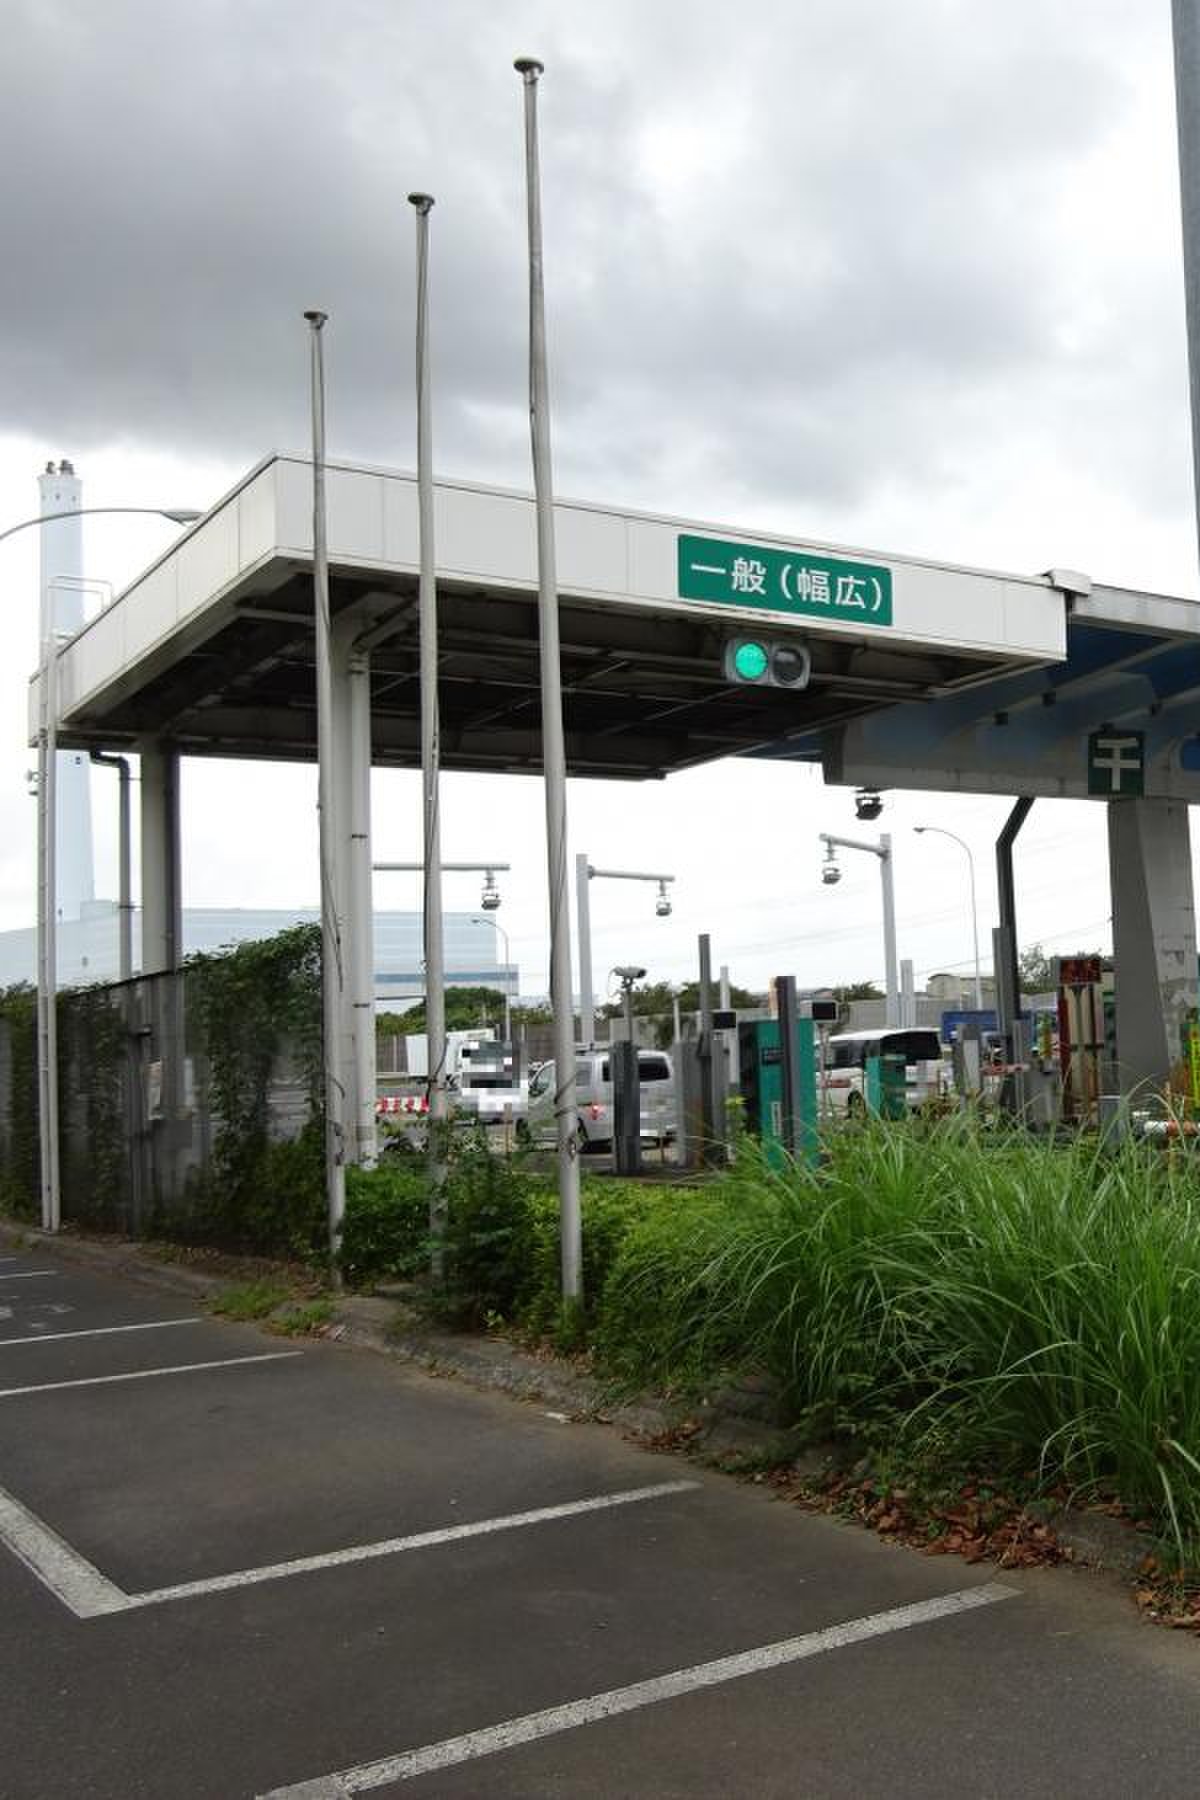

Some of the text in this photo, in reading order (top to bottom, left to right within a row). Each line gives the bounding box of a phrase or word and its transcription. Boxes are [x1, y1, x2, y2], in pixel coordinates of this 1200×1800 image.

[690, 556, 882, 611] 一般（幅広）
[1093, 737, 1141, 791] 千
